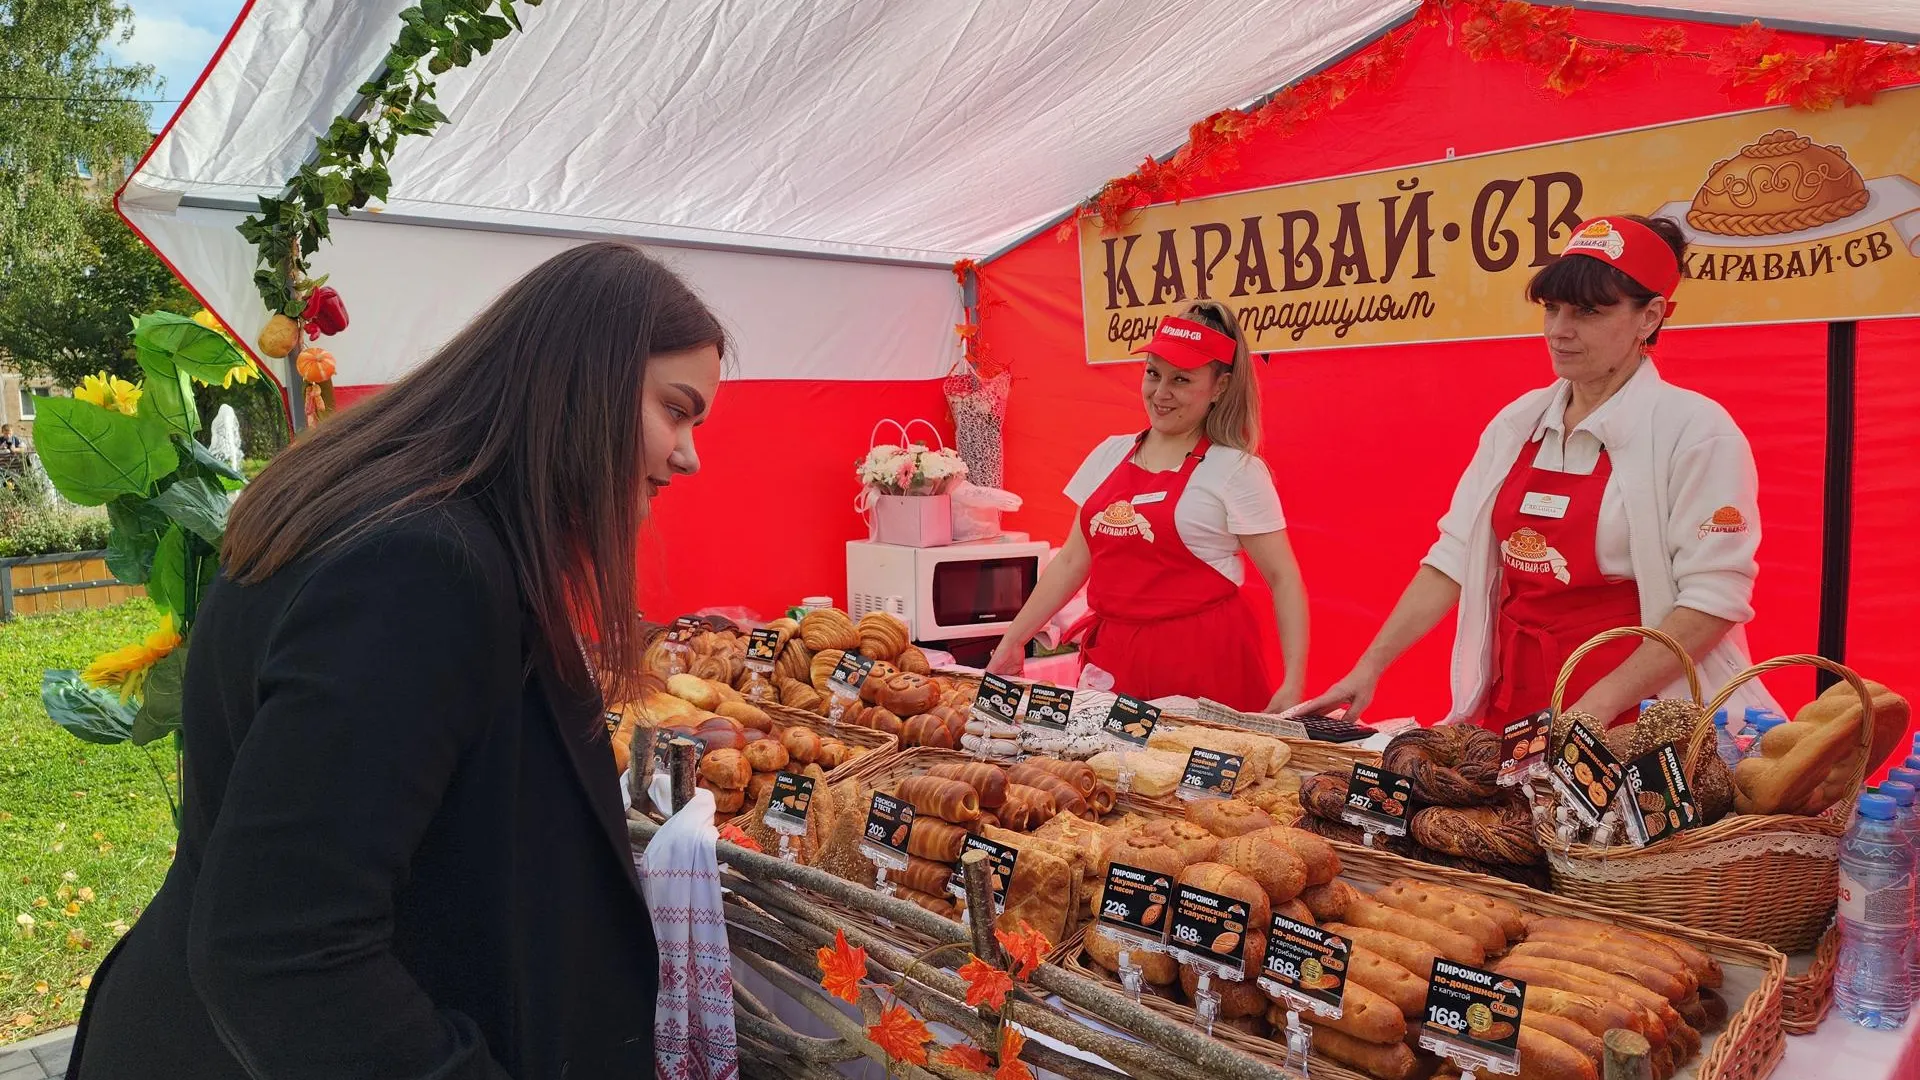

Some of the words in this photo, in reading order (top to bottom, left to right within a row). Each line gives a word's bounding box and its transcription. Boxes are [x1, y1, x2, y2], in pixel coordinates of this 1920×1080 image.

[1108, 312, 1160, 352] верн
[1238, 290, 1435, 342] традициям
[1573, 724, 1596, 748] КАЛАЧ
[1193, 750, 1221, 761] БРЕЦЕЛЬ
[1356, 767, 1378, 779] КАЛАЧ
[1664, 746, 1686, 793] БАТОНЧИК
[875, 796, 897, 809] СОСИСКА
[878, 803, 891, 813] ТЕСТЕ
[968, 838, 997, 854] ХАЧАПУРИ
[1112, 868, 1146, 882] ПИРОЖОК
[1113, 885, 1135, 896] мясом
[1181, 890, 1219, 907] ПИРОЖОК
[1179, 899, 1232, 919] «Акуловский»
[1183, 909, 1217, 924] капустой
[1275, 916, 1324, 941] ПИРОЖОК
[1272, 928, 1335, 957] по-домашнему
[1275, 939, 1313, 957] картофелем
[1275, 947, 1302, 961] грибами
[1436, 962, 1493, 986] ПИРОЖОК
[1434, 975, 1506, 1002] по-домашнему
[1438, 986, 1471, 1001] капустой
[1492, 1002, 1508, 1013] 0,08
